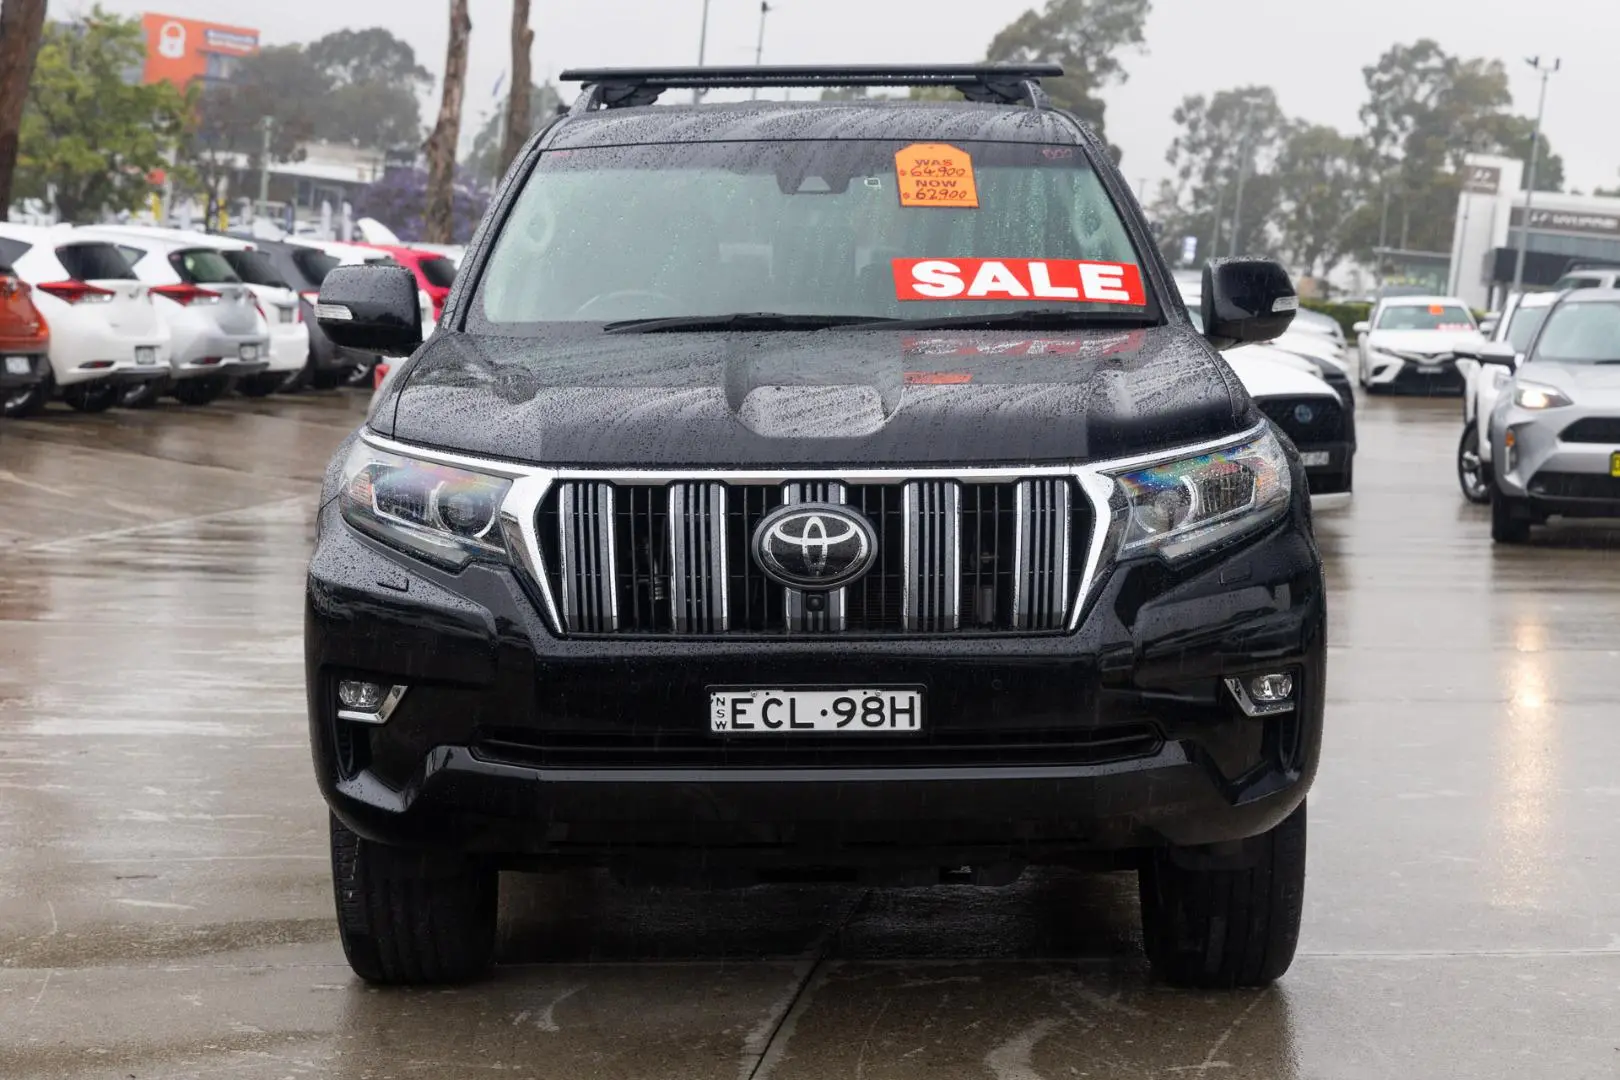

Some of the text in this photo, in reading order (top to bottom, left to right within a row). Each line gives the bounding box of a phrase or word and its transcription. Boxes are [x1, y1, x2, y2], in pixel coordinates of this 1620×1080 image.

[915, 159, 953, 167] WAS
[915, 180, 957, 188] NOW
[911, 260, 1130, 301] SALE
